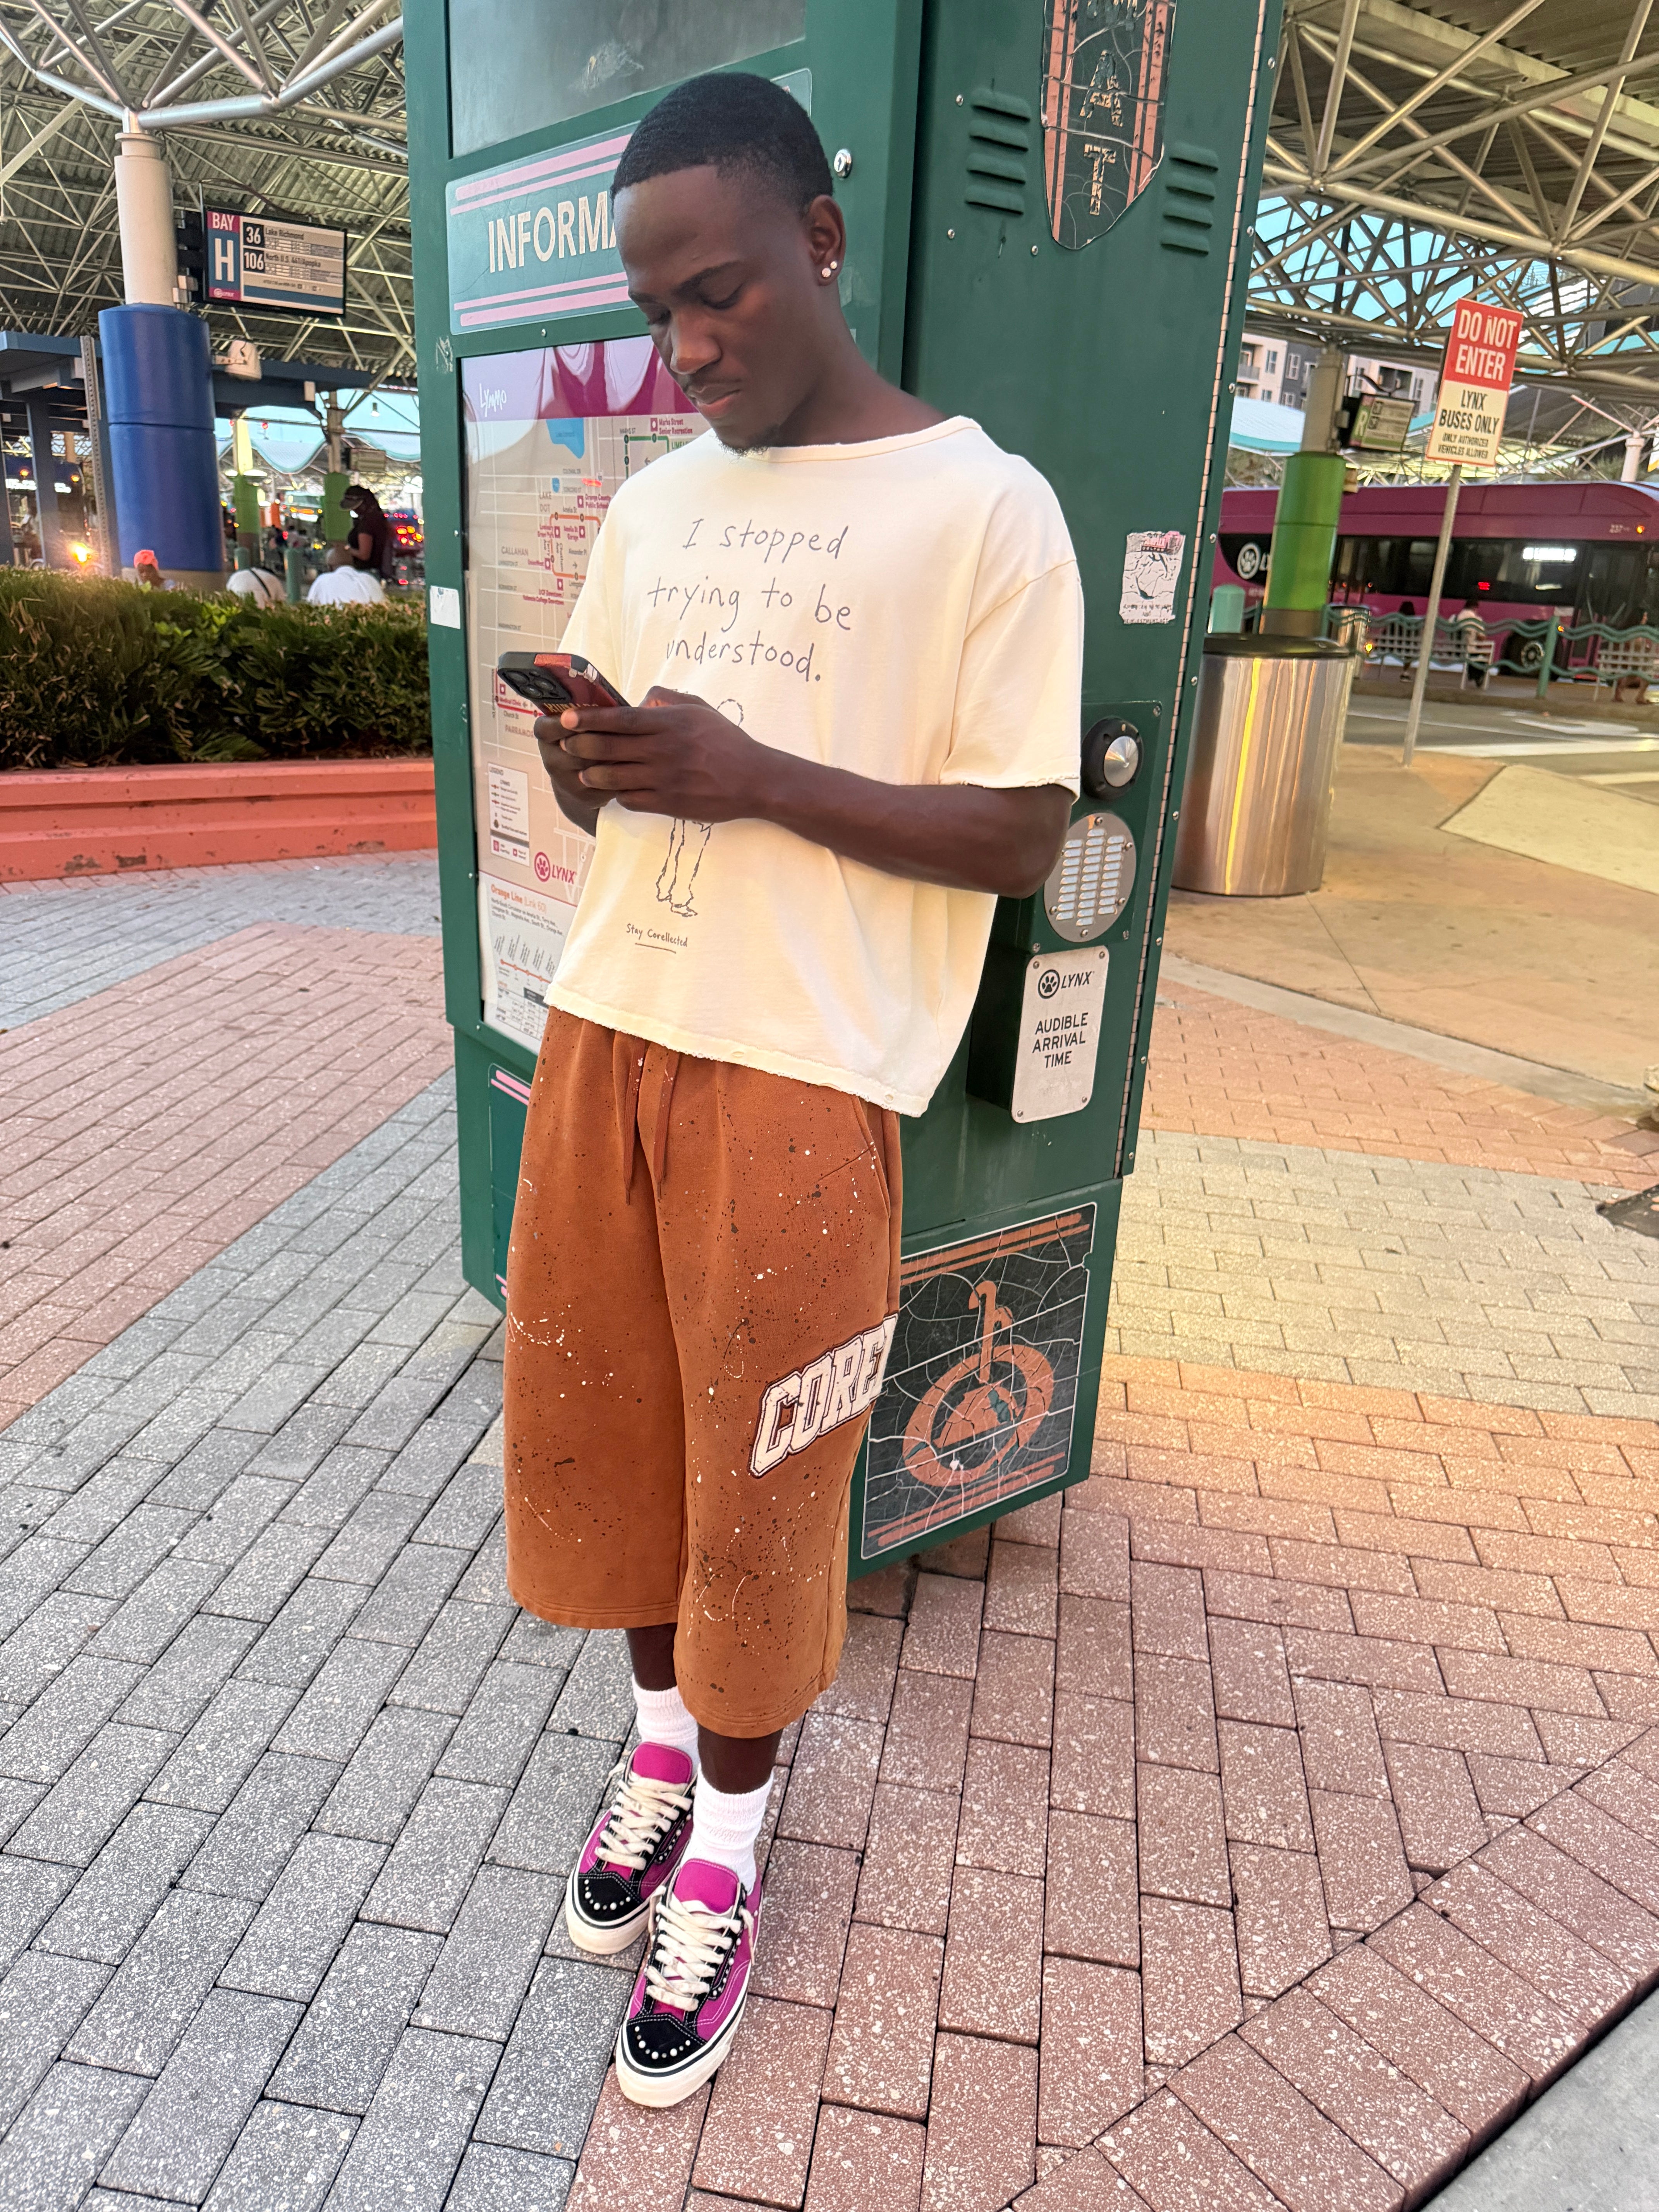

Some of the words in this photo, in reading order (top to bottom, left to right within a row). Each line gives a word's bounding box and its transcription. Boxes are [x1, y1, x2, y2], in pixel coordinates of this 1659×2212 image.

[213, 212, 235, 231] BAY
[246, 226, 261, 244] 36
[215, 238, 234, 282] H
[244, 252, 264, 270] 106
[1457, 309, 1482, 342] DO
[1484, 315, 1518, 349] NOT
[1455, 344, 1506, 381] ENTER
[1460, 390, 1486, 411] LYNX
[1355, 410, 1368, 436] R
[1439, 409, 1473, 431] BUSES
[1474, 414, 1500, 434] ONLY
[1442, 433, 1457, 443] ONLY
[501, 546, 529, 556] CALLAHAN
[682, 518, 704, 550] I
[719, 519, 849, 564] stopped
[647, 575, 740, 633] trying
[761, 577, 793, 608] to
[814, 583, 851, 630] be
[666, 630, 821, 682] understood.
[552, 864, 575, 884] LYNX
[491, 884, 510, 900] Orange
[511, 891, 522, 904] Line
[626, 923, 643, 940] Stay
[647, 928, 688, 947] Corellected
[1061, 971, 1092, 989] LYNX
[1035, 1012, 1089, 1035] AUDIBLE
[1032, 1030, 1086, 1053] ARRIVAL
[1044, 1051, 1072, 1069] TIME
